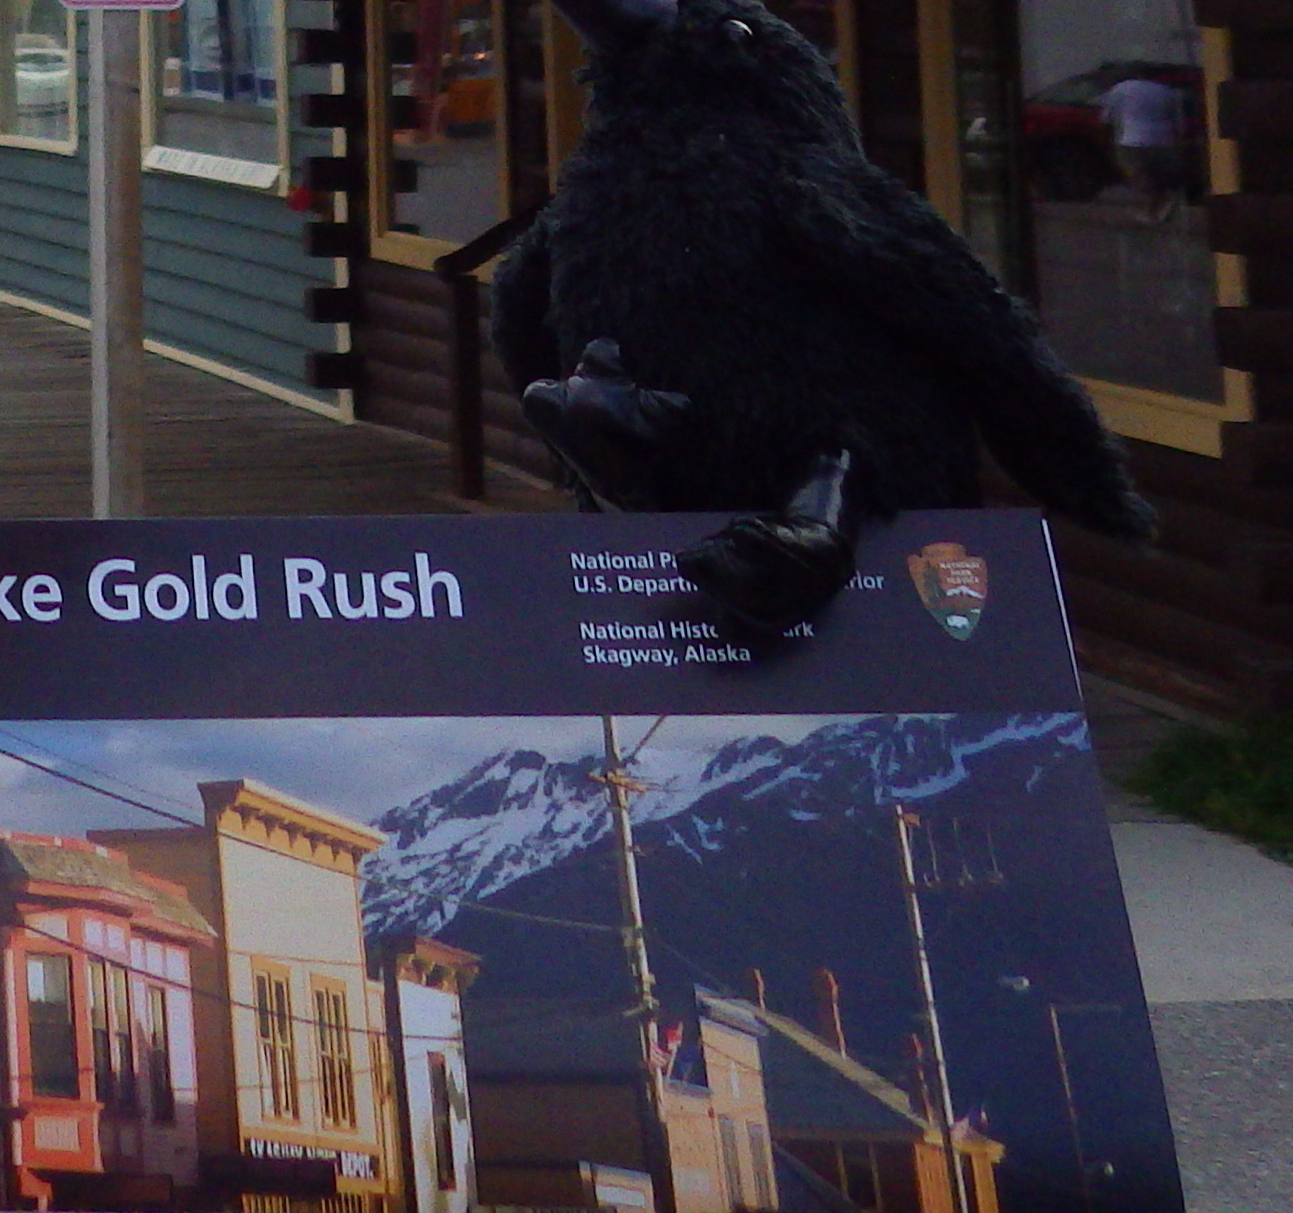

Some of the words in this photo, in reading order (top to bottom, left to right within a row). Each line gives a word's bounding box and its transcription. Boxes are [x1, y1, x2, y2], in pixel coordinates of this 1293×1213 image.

[570, 550, 654, 570] National
[88, 553, 258, 621] Gold
[284, 552, 464, 620] Rush
[573, 575, 613, 593] U.S.
[618, 574, 699, 596] Depart
[579, 620, 664, 640] National
[583, 644, 679, 668] Skagway,
[684, 644, 752, 663] Alaska
